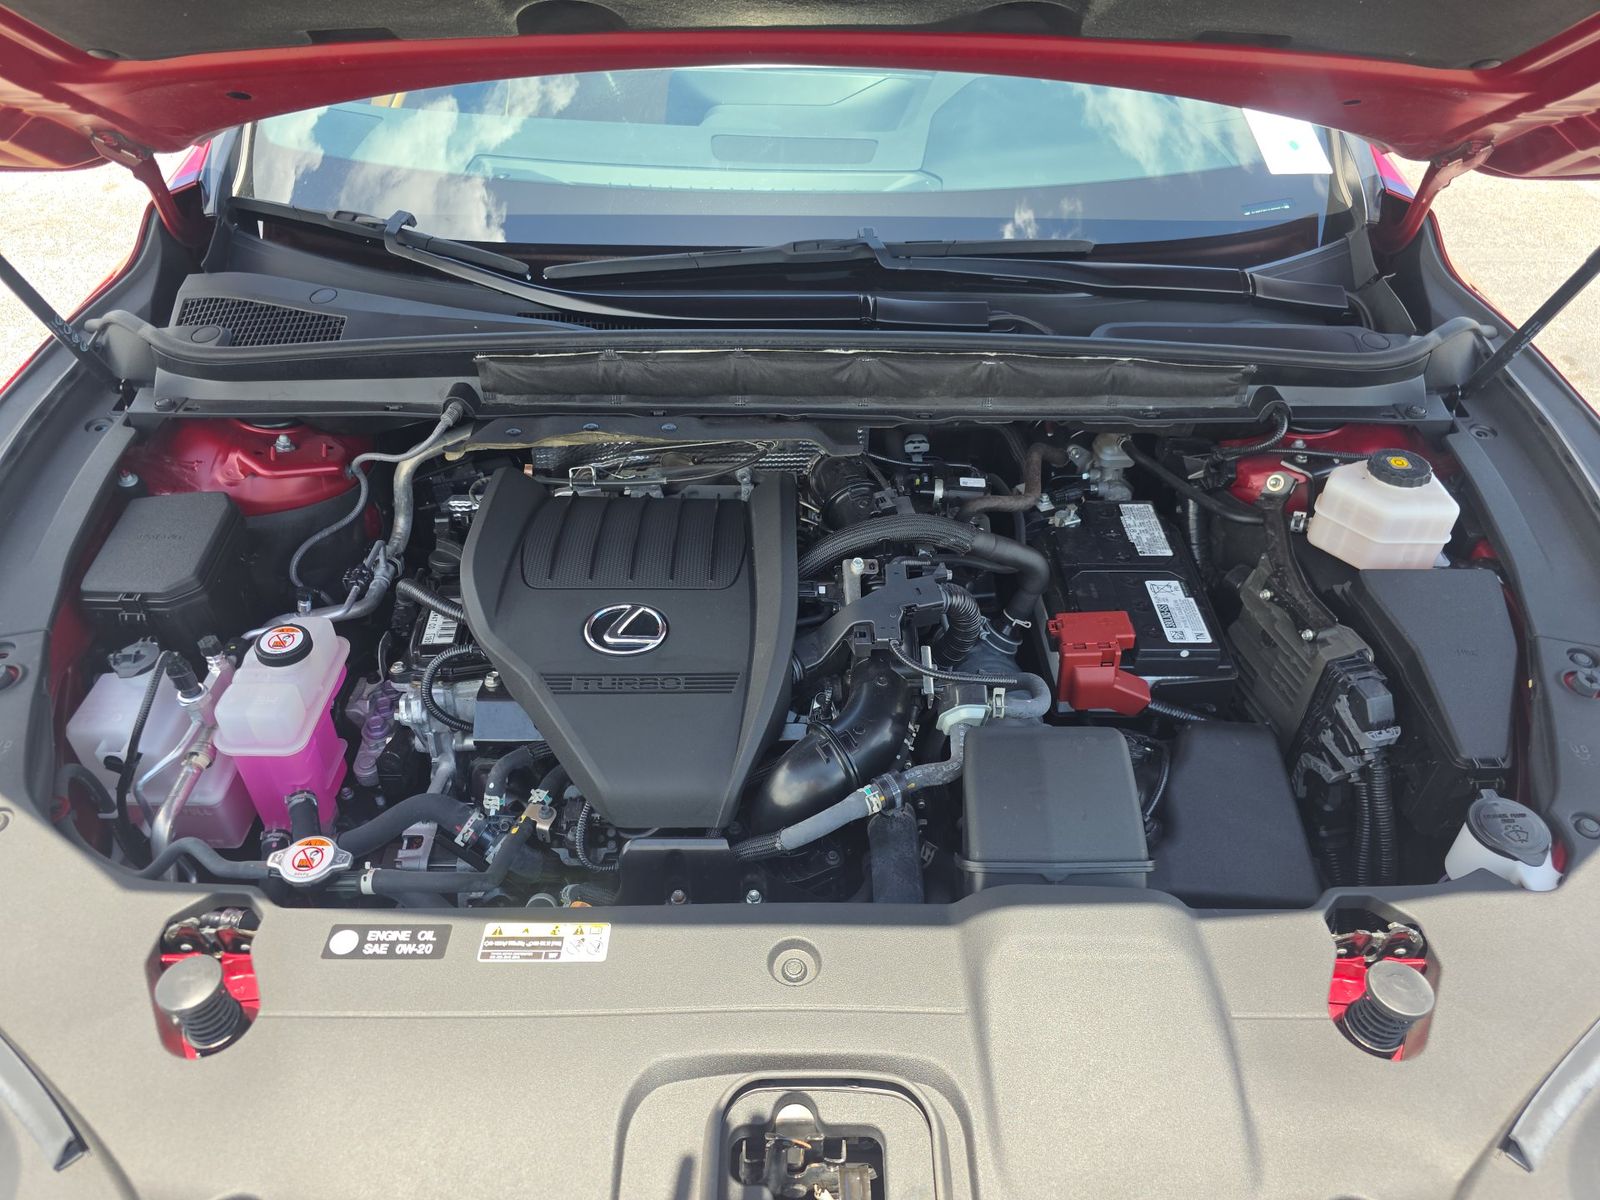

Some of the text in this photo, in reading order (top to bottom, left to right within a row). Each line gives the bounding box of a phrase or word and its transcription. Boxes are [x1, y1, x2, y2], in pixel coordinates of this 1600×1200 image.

[574, 676, 684, 690] TURBO
[366, 930, 437, 941] ENGINE OIL
[362, 943, 389, 955] SAE
